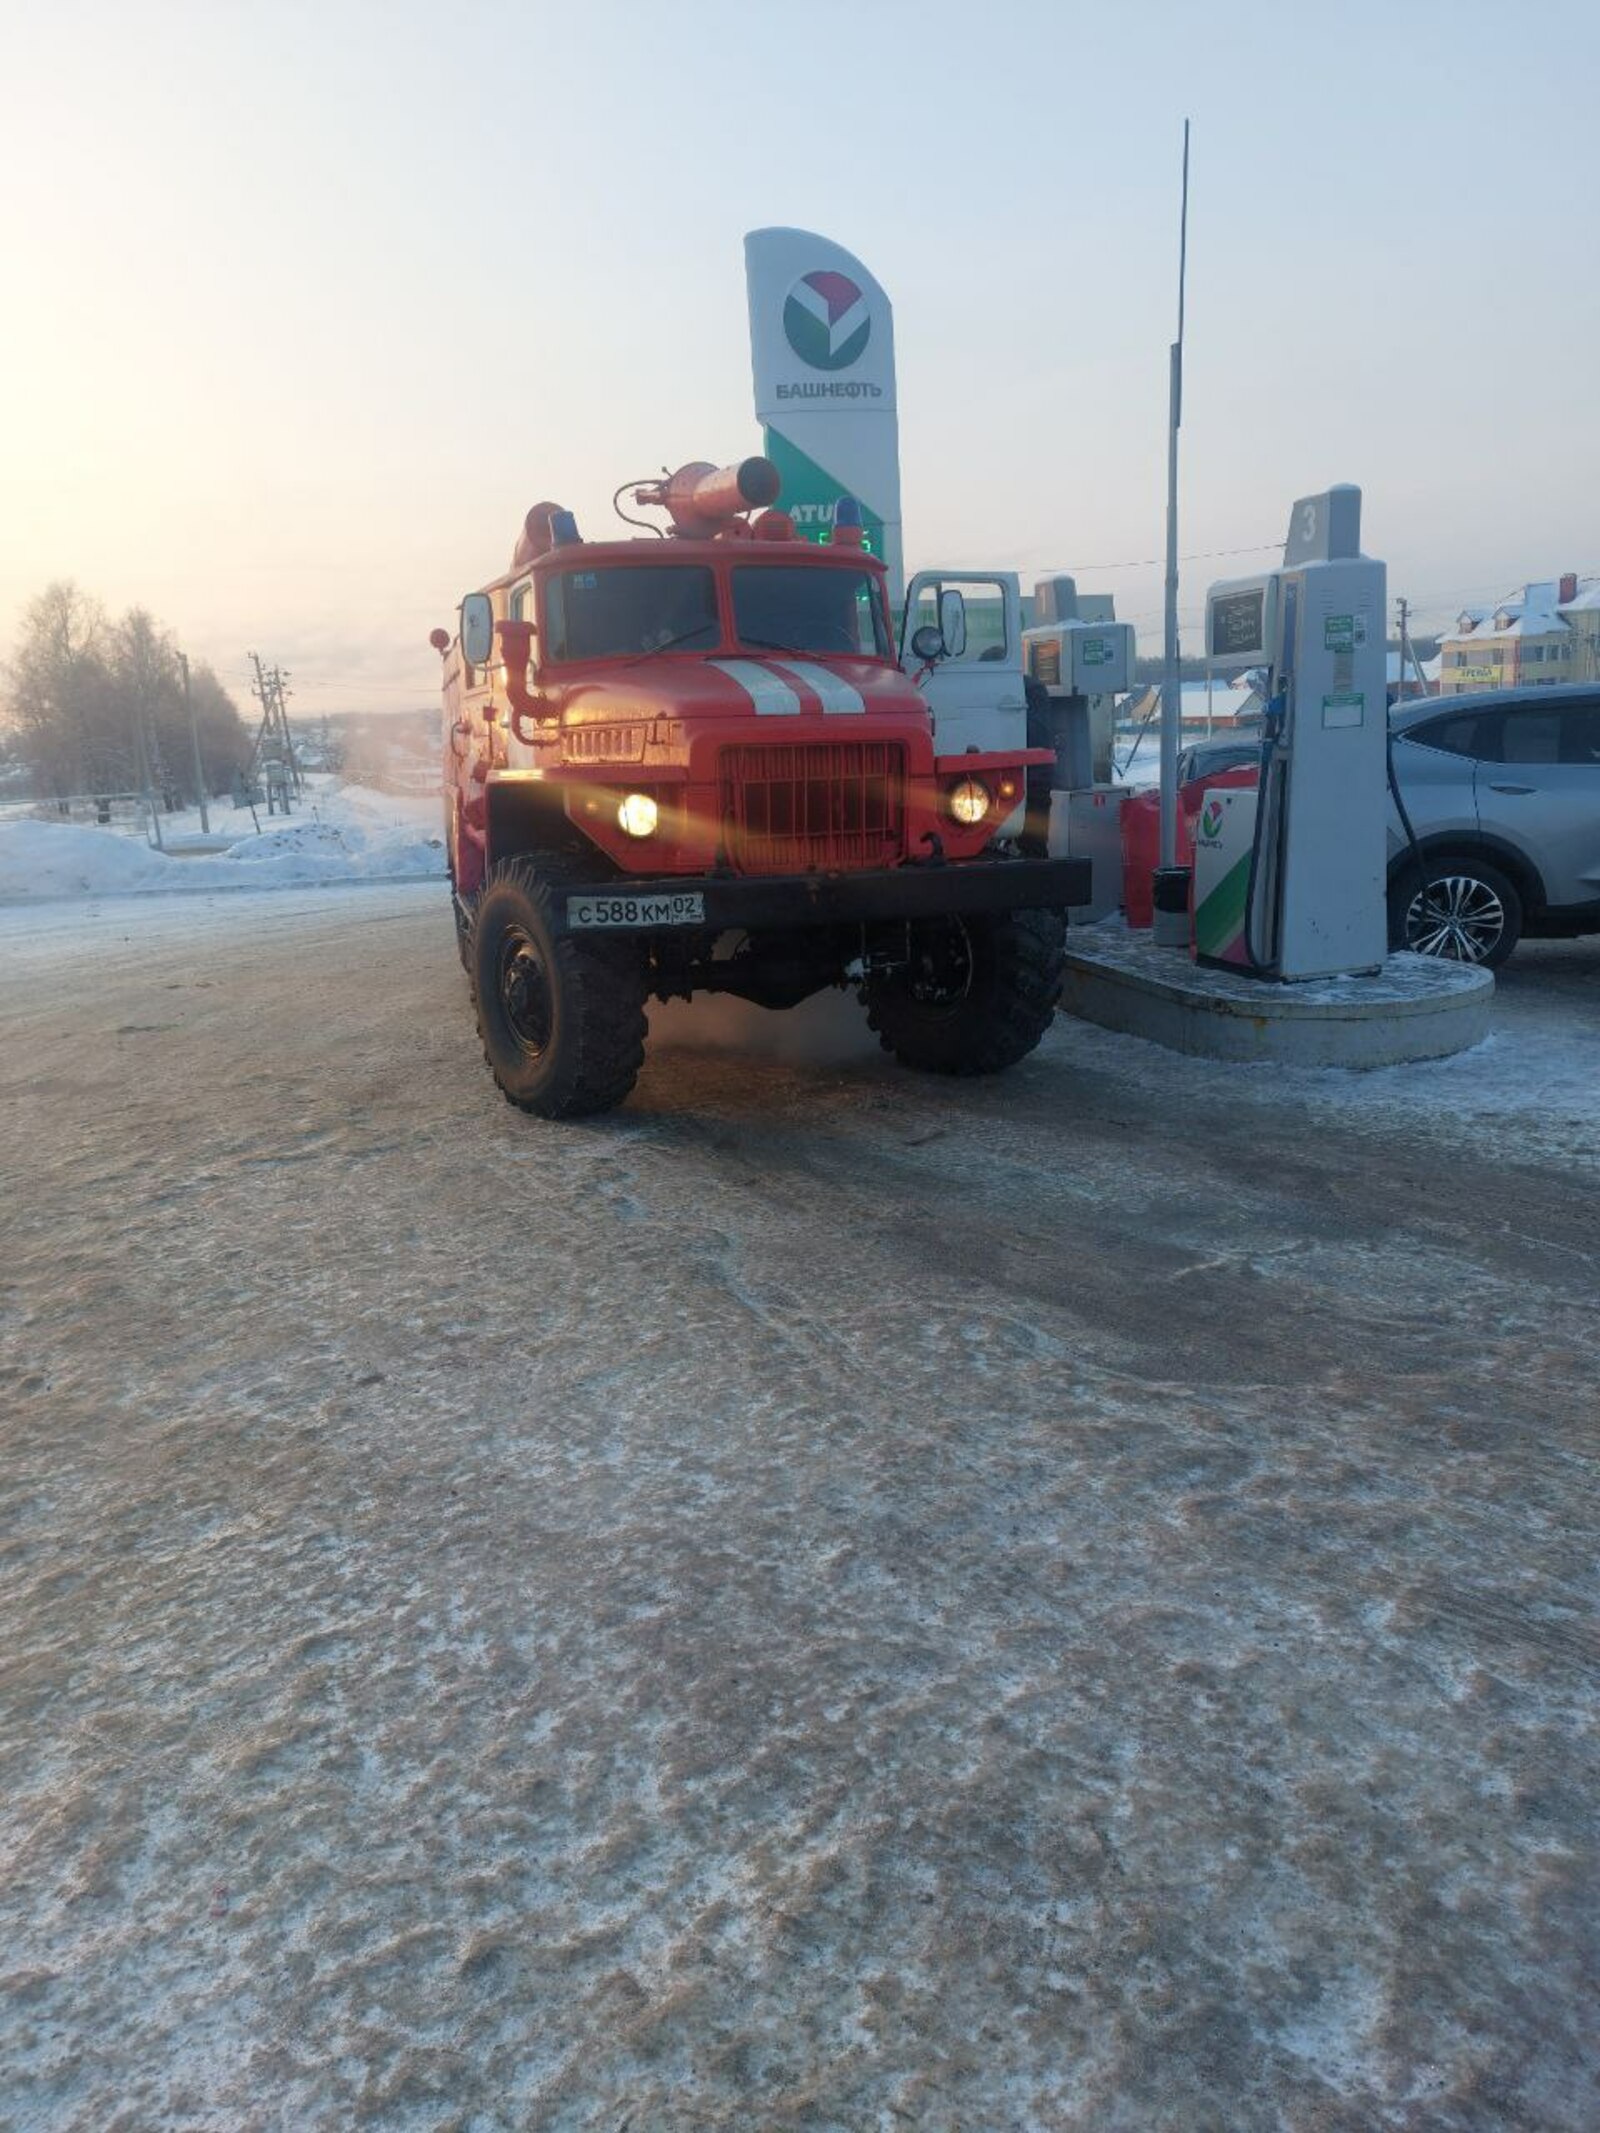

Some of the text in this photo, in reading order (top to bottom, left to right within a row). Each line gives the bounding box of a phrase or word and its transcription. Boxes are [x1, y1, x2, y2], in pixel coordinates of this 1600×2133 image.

[776, 382, 882, 399] БАШНЕФТЬ
[1302, 504, 1316, 541] 3
[673, 897, 695, 914] 02
